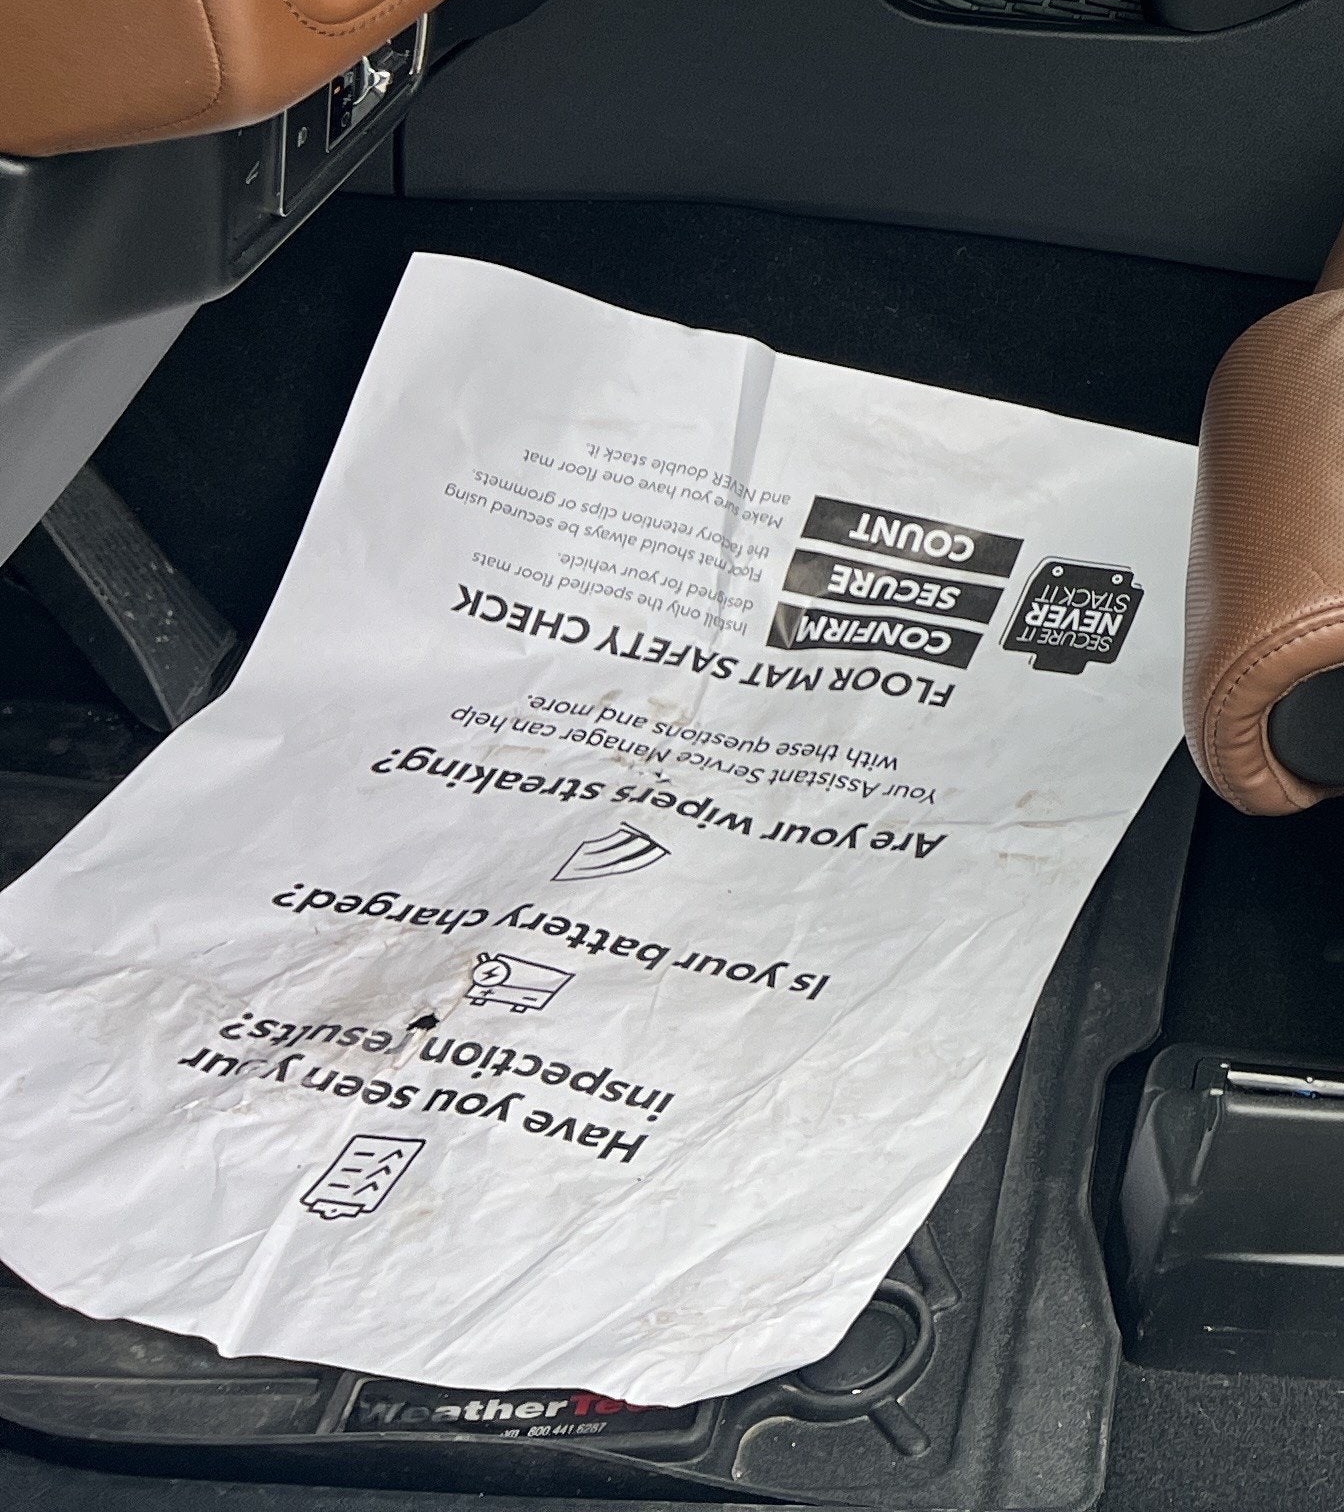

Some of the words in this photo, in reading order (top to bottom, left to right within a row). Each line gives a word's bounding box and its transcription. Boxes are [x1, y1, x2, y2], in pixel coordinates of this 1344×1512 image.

[520, 447, 554, 470] mat
[584, 441, 600, 458] it.
[602, 444, 647, 470] stack
[556, 458, 597, 483] floor
[600, 468, 634, 489] one
[649, 456, 708, 482] double
[442, 481, 487, 509] using
[469, 466, 555, 505] grommets.
[636, 474, 676, 501] have
[678, 484, 709, 504] you
[709, 470, 756, 503] NEVER
[757, 488, 790, 508] and
[488, 498, 554, 530] secured
[555, 496, 576, 511] or
[579, 497, 617, 521] clips
[711, 494, 738, 517] sure
[556, 518, 579, 539] be
[619, 510, 692, 537] retention
[739, 507, 783, 530] Make
[581, 521, 637, 550] always
[694, 525, 742, 557] factory
[744, 539, 769, 560] the
[847, 511, 974, 561] COUNT
[470, 549, 510, 572] mats
[555, 550, 616, 577] vehicle.
[639, 536, 694, 565] should
[696, 550, 726, 571] mat
[512, 563, 553, 586] floor
[618, 564, 660, 584] your
[658, 575, 683, 595] for
[727, 560, 762, 582] Floor
[556, 574, 633, 602] specified
[684, 581, 753, 612] designed
[826, 562, 960, 609] SECURE
[450, 583, 590, 644] CHECK
[635, 592, 662, 615] the
[665, 598, 700, 620] only
[1023, 600, 1122, 634] NEVER
[702, 611, 747, 635] Install
[794, 614, 951, 654] CONFIRM
[1015, 625, 1035, 642] IT
[593, 623, 738, 679] SAFETY
[1038, 628, 1112, 651] SECURE
[738, 662, 823, 691] MAT
[828, 666, 955, 707] FLOOR
[449, 704, 507, 733] help
[524, 692, 596, 718] more.
[510, 716, 556, 739] can
[597, 705, 648, 736] and
[560, 723, 671, 764] Manager
[652, 720, 769, 756] questions
[775, 739, 839, 762] these
[674, 748, 763, 783] Service
[844, 746, 897, 772] with
[369, 744, 605, 803] streaking?
[767, 766, 880, 798] Assistant
[882, 781, 936, 803] Your
[612, 783, 753, 838] wipers
[761, 820, 867, 850] your
[868, 830, 947, 858] Are
[270, 881, 489, 934] charged?
[495, 902, 669, 969] battery
[671, 950, 787, 991] your
[789, 972, 829, 1001] Is
[218, 1010, 412, 1055] results?
[301, 1065, 418, 1108] seen
[418, 1034, 675, 1121] inspection
[421, 1086, 523, 1122] you
[523, 1109, 648, 1163] Have
[358, 1393, 667, 1426] WeatherTe
